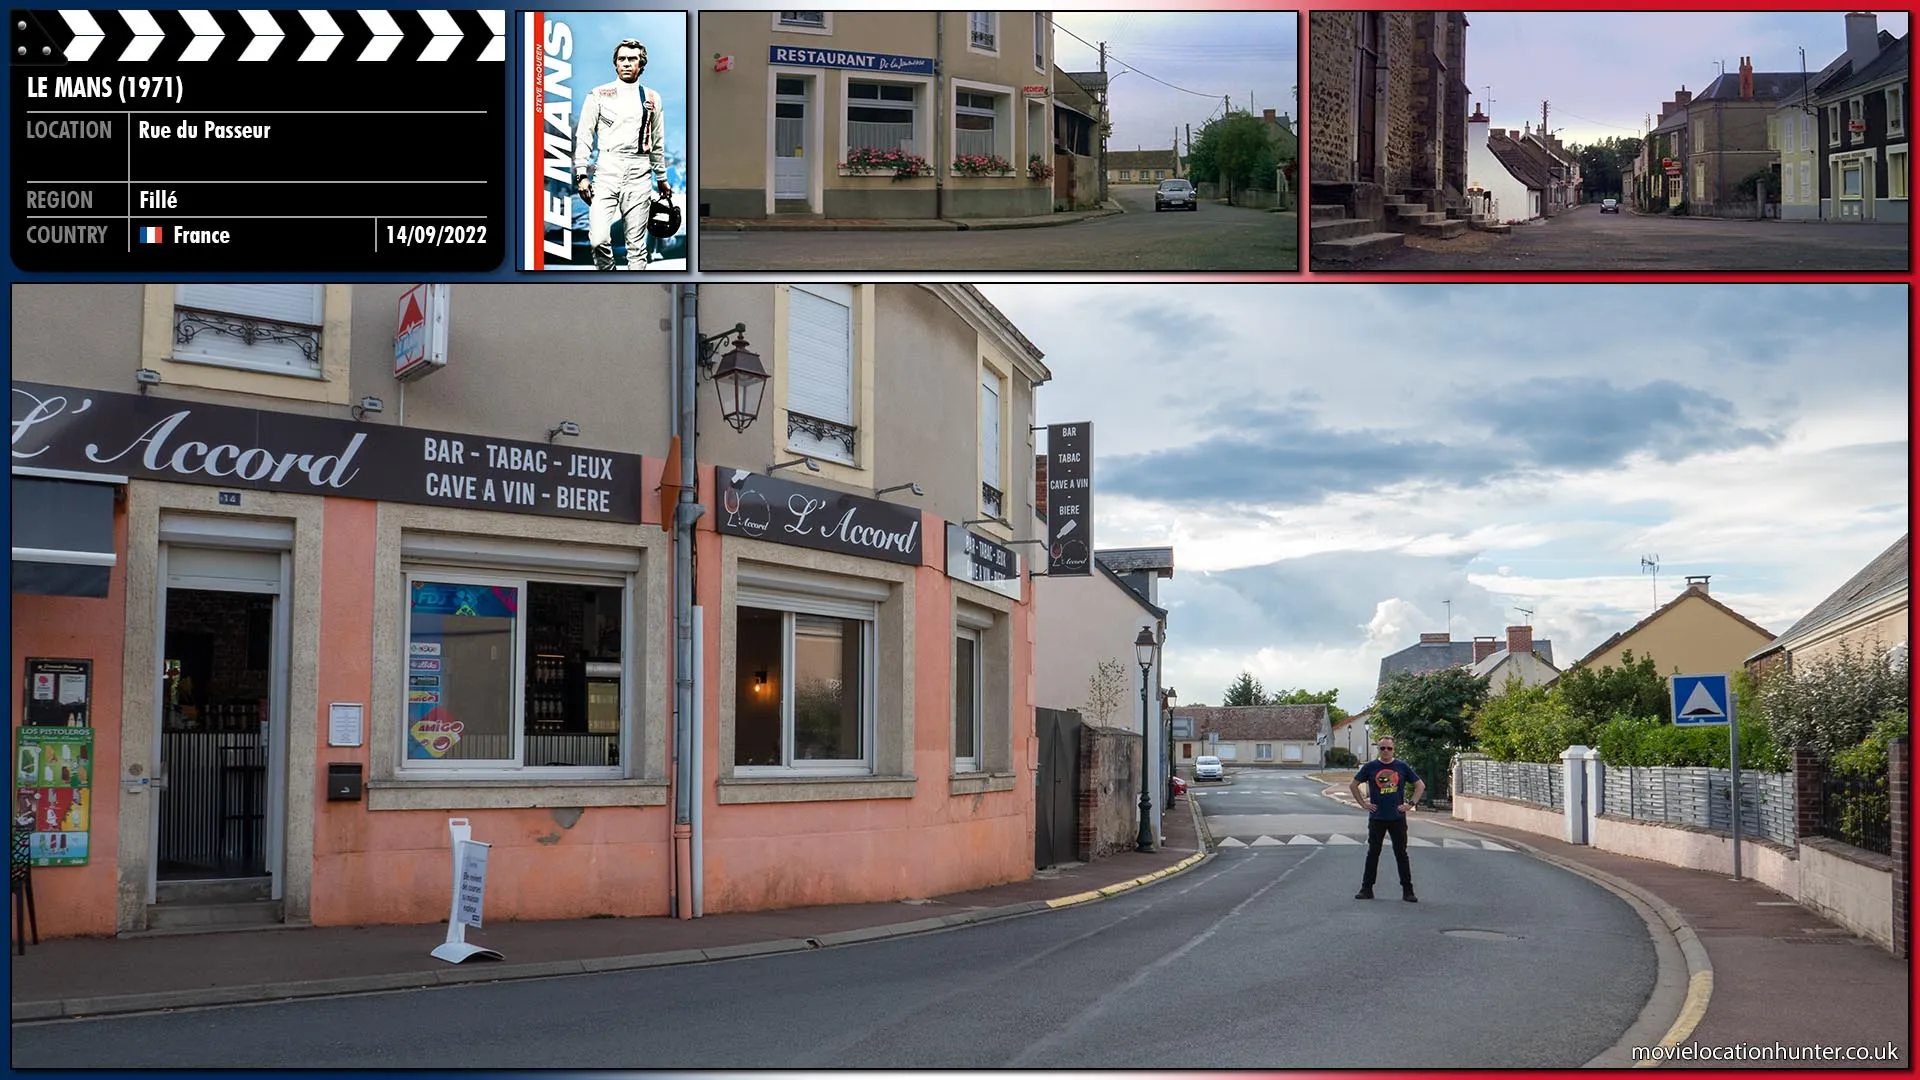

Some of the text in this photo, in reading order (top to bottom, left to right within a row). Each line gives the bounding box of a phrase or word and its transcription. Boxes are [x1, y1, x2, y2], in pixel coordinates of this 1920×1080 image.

[777, 49, 876, 67] RESTAURANT
[544, 20, 573, 261] LE MANS
[1062, 427, 1077, 437] BAR
[425, 437, 464, 465] BAR
[486, 444, 547, 473] TABAC
[568, 455, 612, 480] JEUX
[1058, 453, 1081, 464] TABAC
[1050, 478, 1089, 490] CAVE A VIN
[426, 472, 477, 500] CAVE
[483, 479, 496, 502] A
[503, 480, 535, 505] VIN
[557, 486, 610, 513] BIERE
[1059, 505, 1080, 516] BIERE
[784, 493, 919, 554] L'Accord
[40, 728, 90, 736] PISTOLEROS
